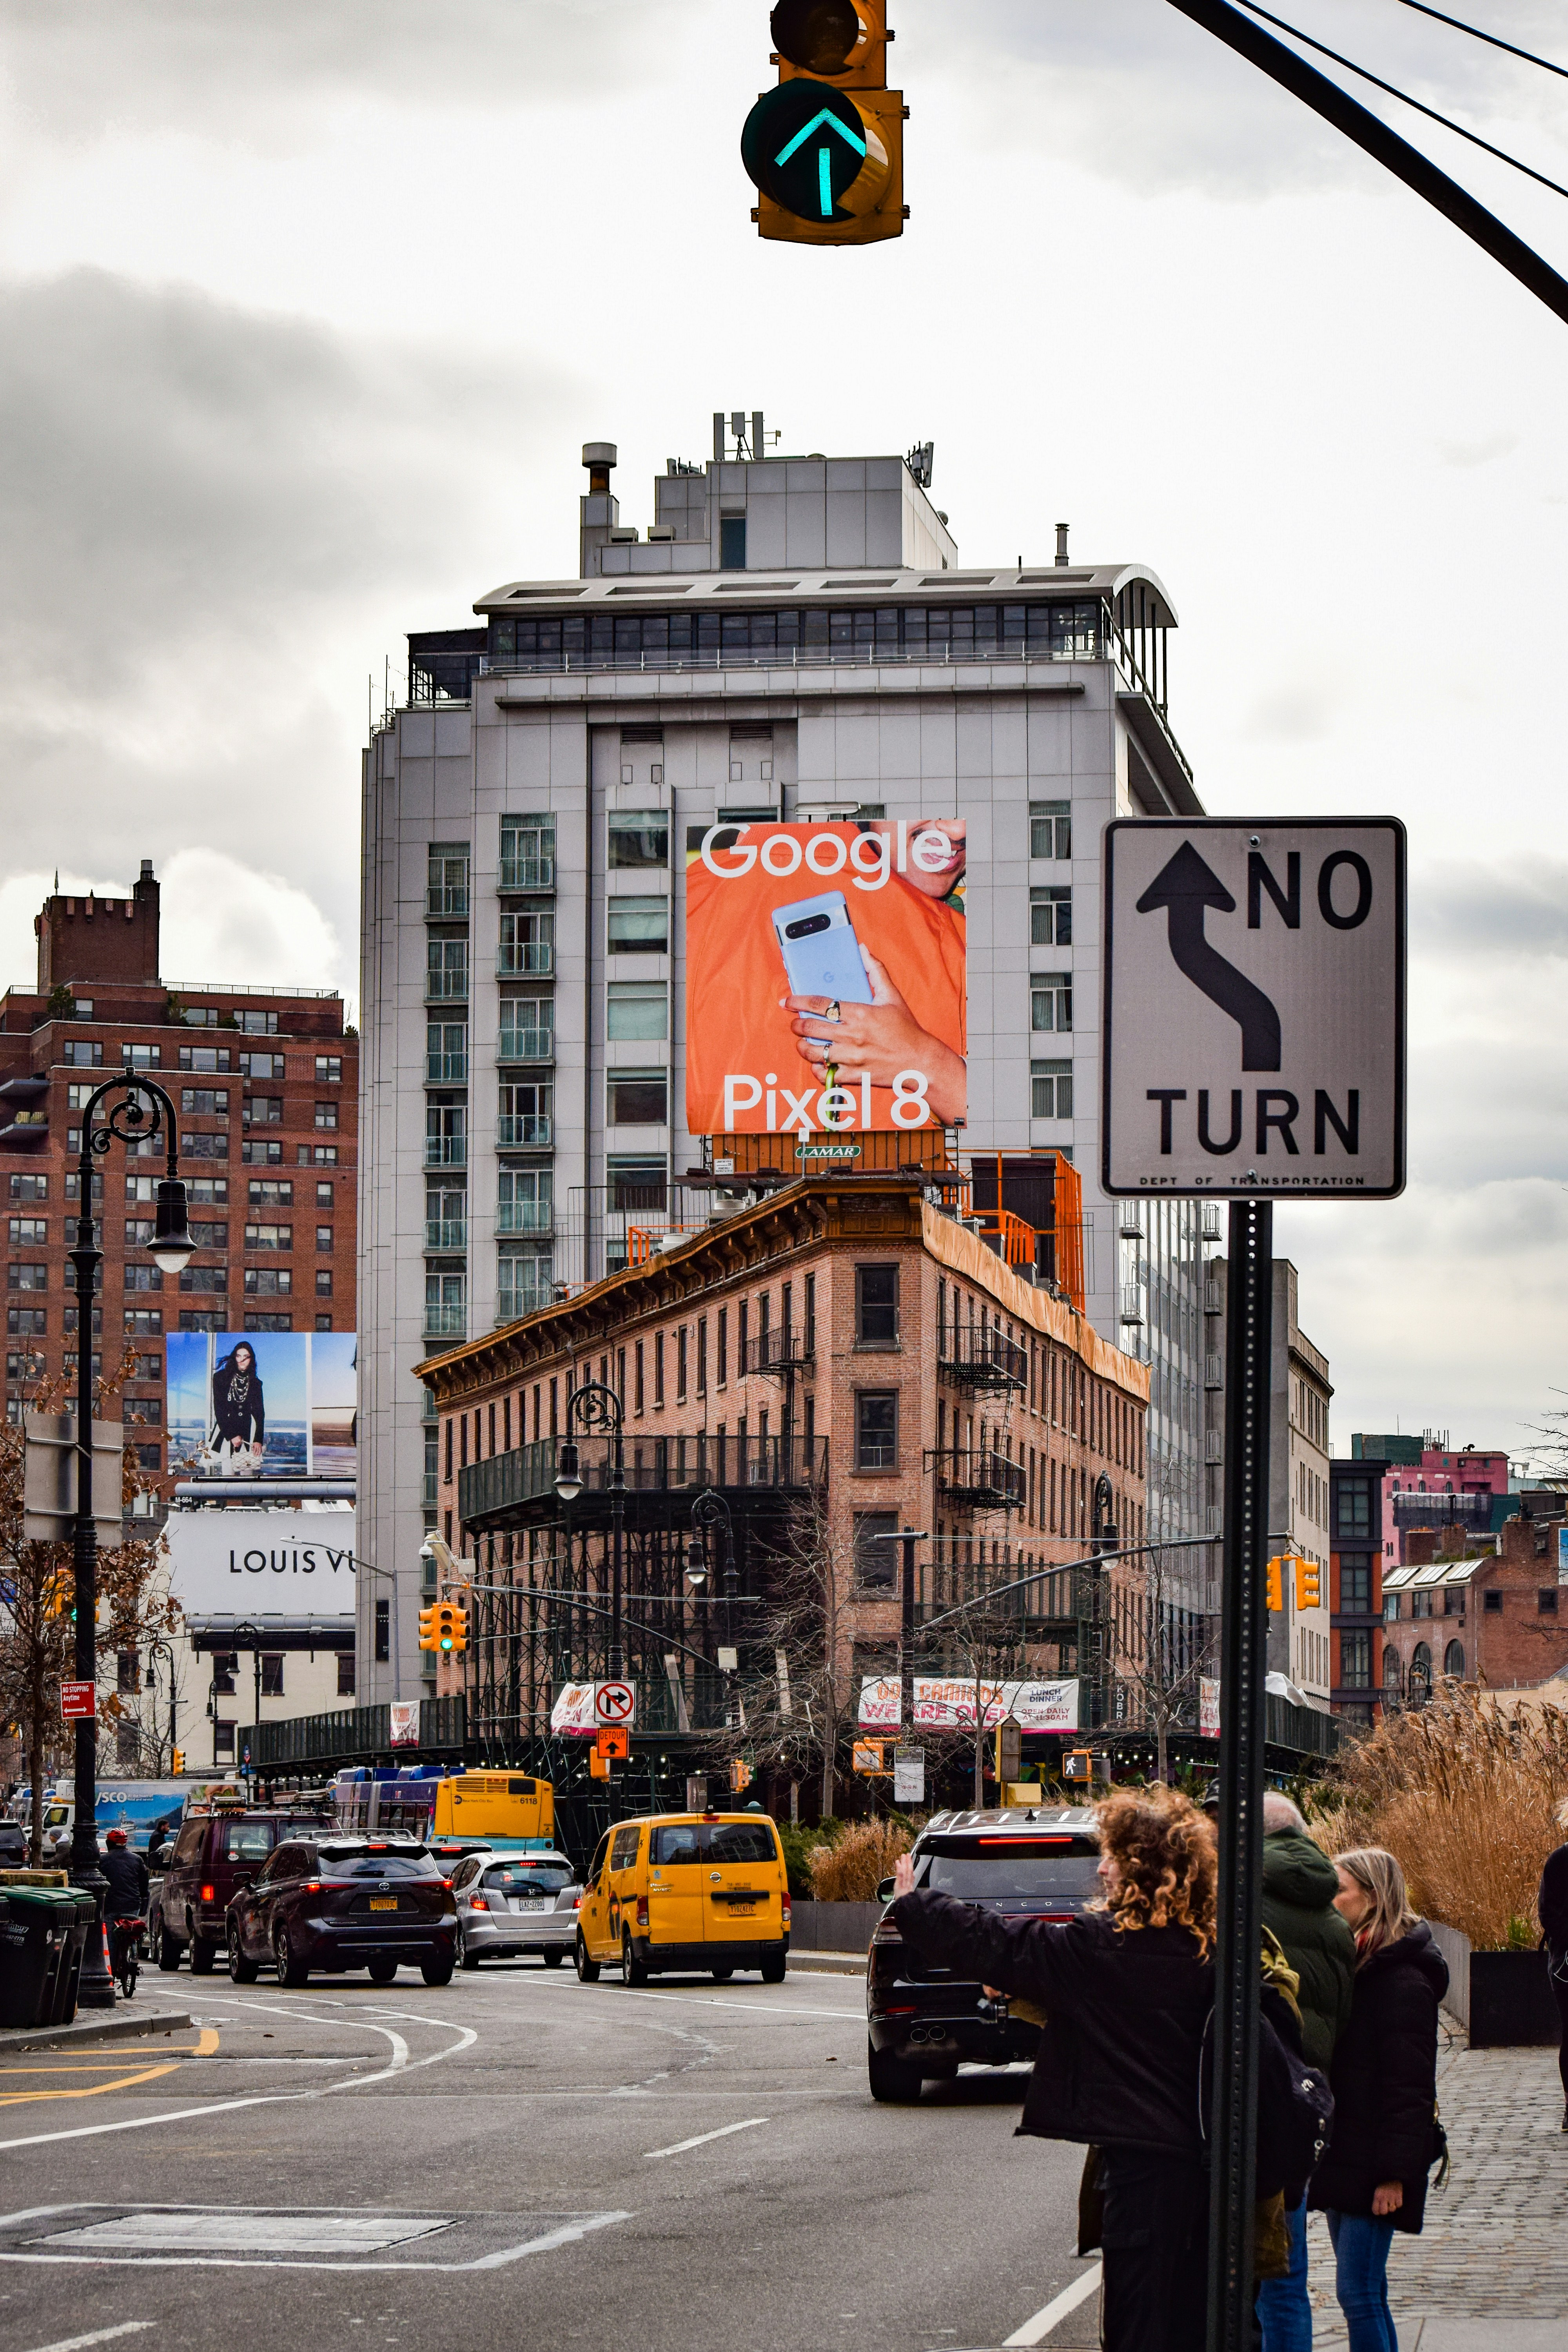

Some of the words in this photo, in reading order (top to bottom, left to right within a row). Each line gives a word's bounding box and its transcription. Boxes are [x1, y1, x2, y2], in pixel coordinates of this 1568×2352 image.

[701, 820, 951, 891] Google
[1247, 850, 1372, 930] NO
[724, 1072, 871, 1132] Pixel
[890, 1069, 930, 1129] 8
[1146, 1089, 1359, 1155] TURN
[1231, 1177, 1365, 1185] TRANSPORTATION
[230, 1550, 316, 1573] LOUIS
[877, 1682, 901, 1700] DO
[865, 1703, 897, 1718] WE
[600, 1731, 625, 1740] DETOUR
